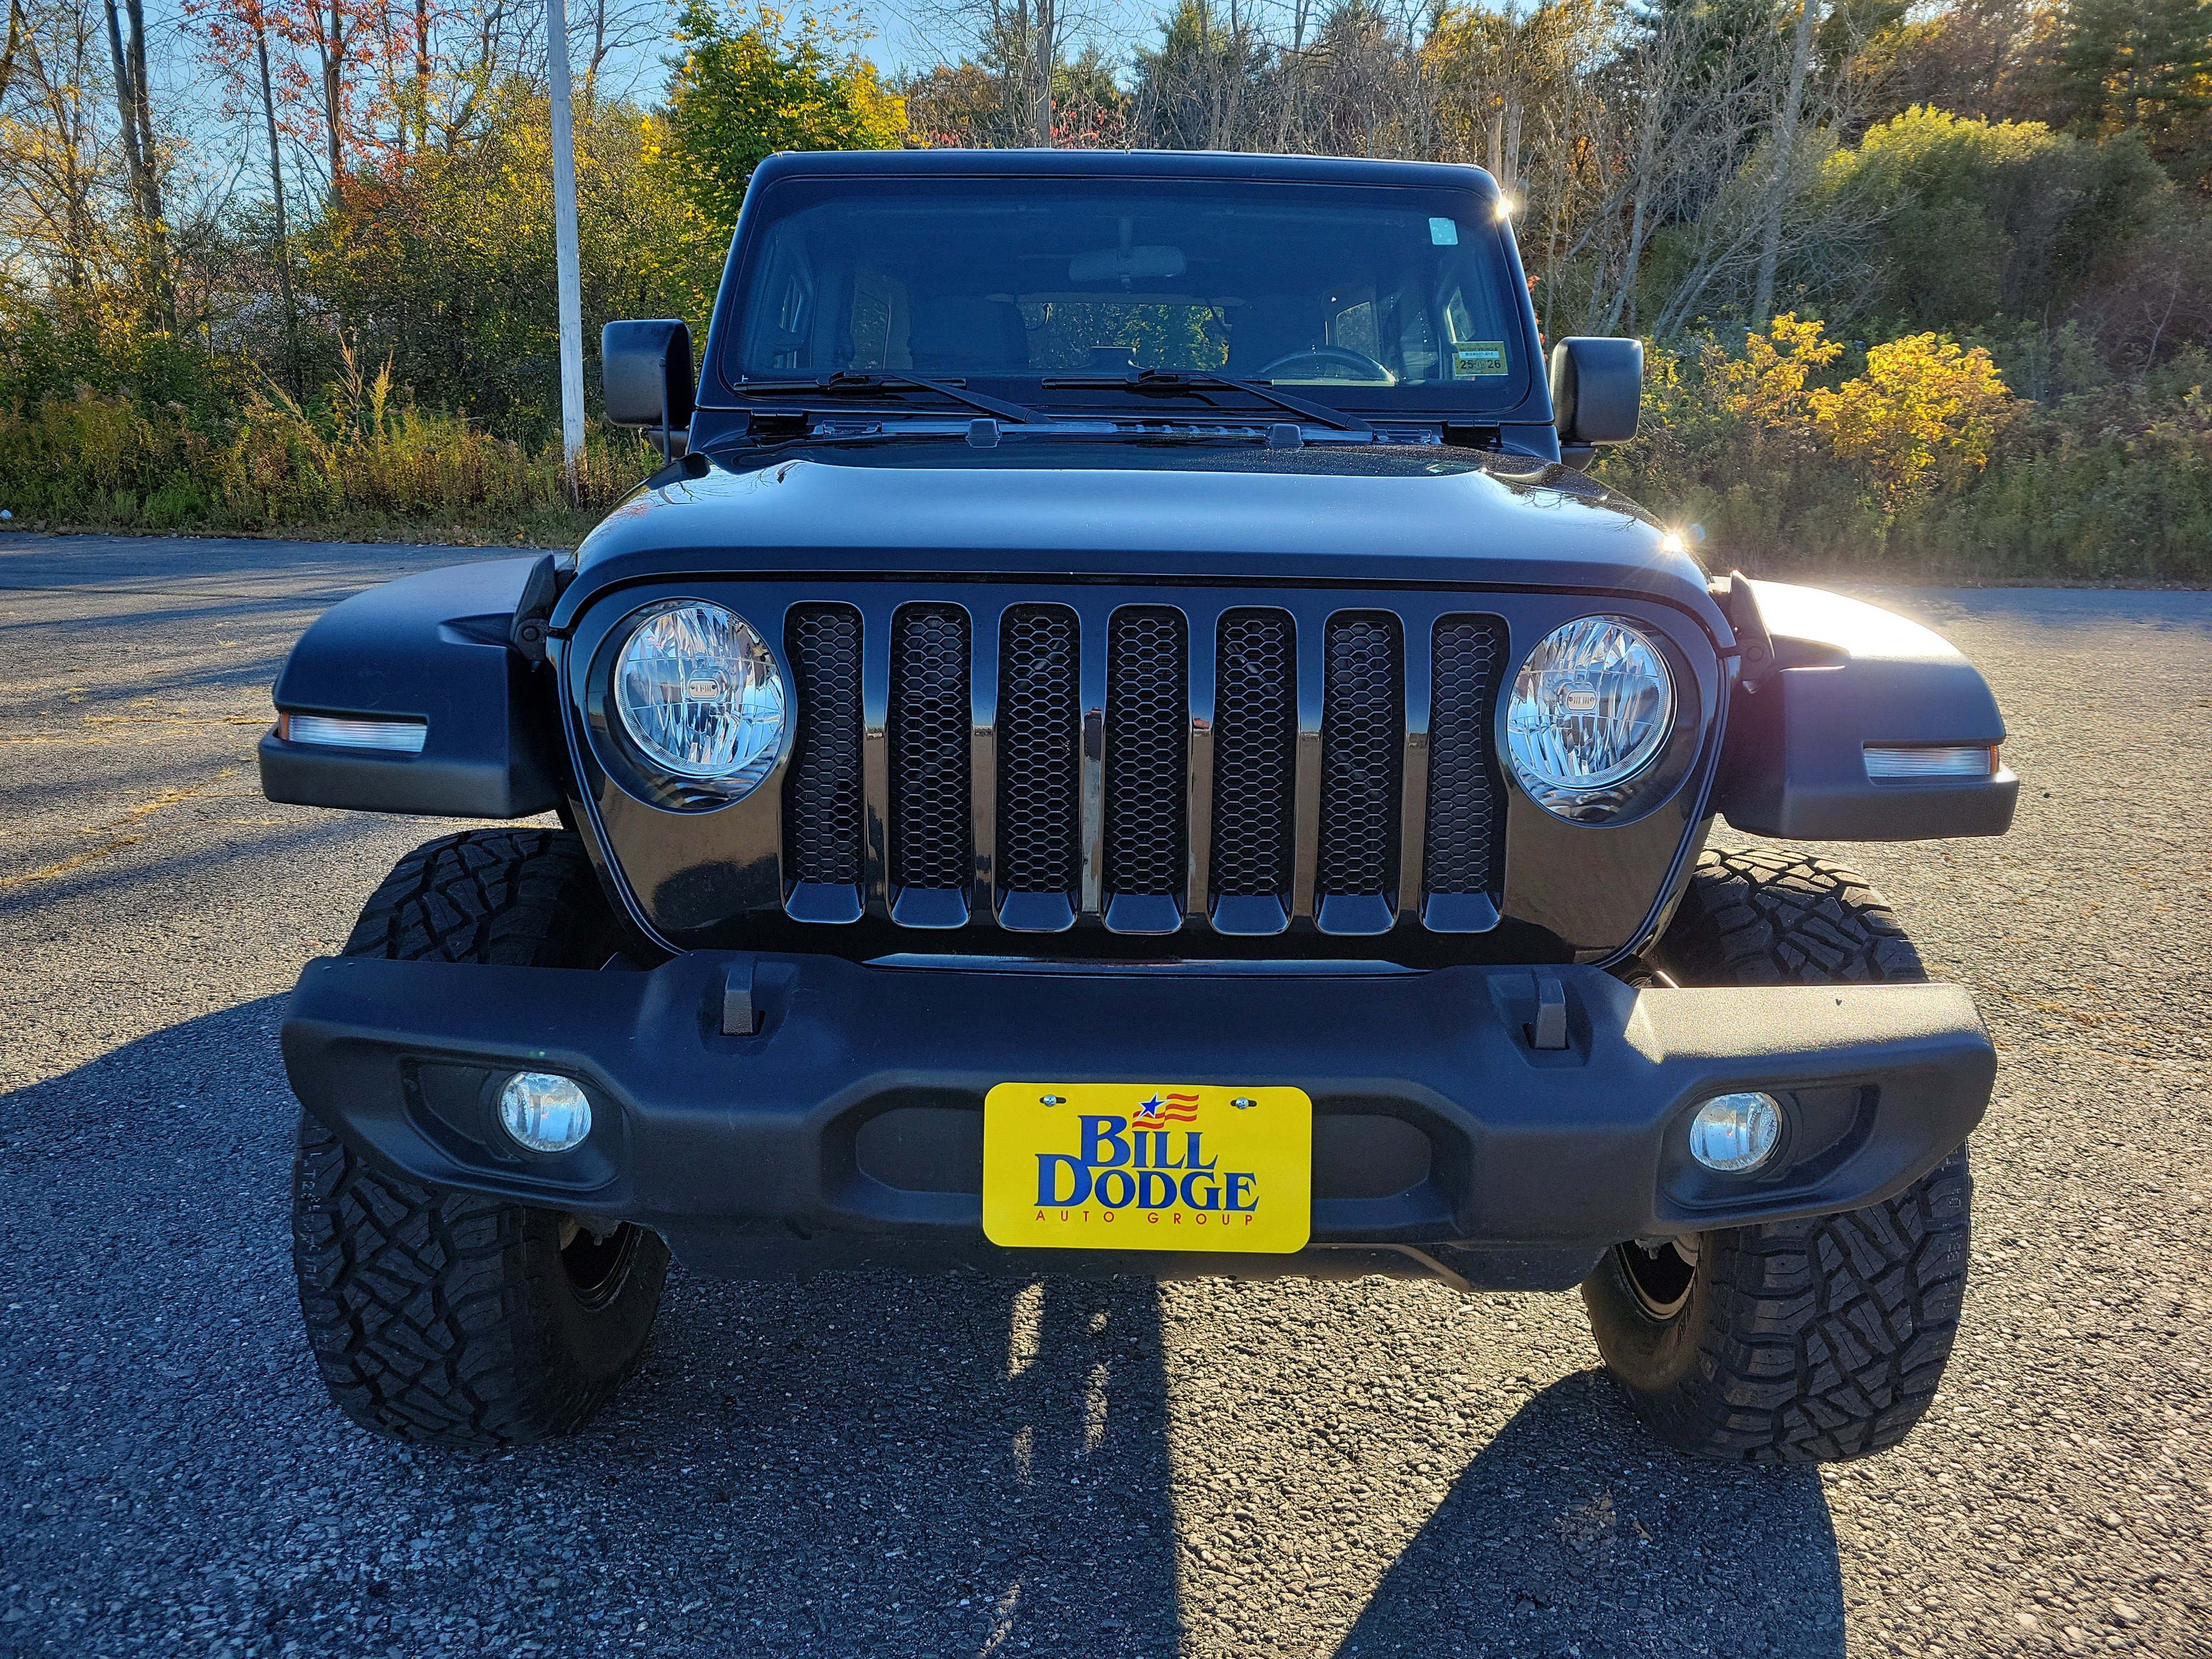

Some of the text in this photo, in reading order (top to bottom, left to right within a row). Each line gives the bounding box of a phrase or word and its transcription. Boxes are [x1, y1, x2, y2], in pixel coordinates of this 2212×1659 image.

[1487, 359, 1501, 369] 26
[1077, 1115, 1218, 1170] BILL
[1034, 1153, 1260, 1212] DODGE
[1035, 1210, 1253, 1226] AUTO GROUP
